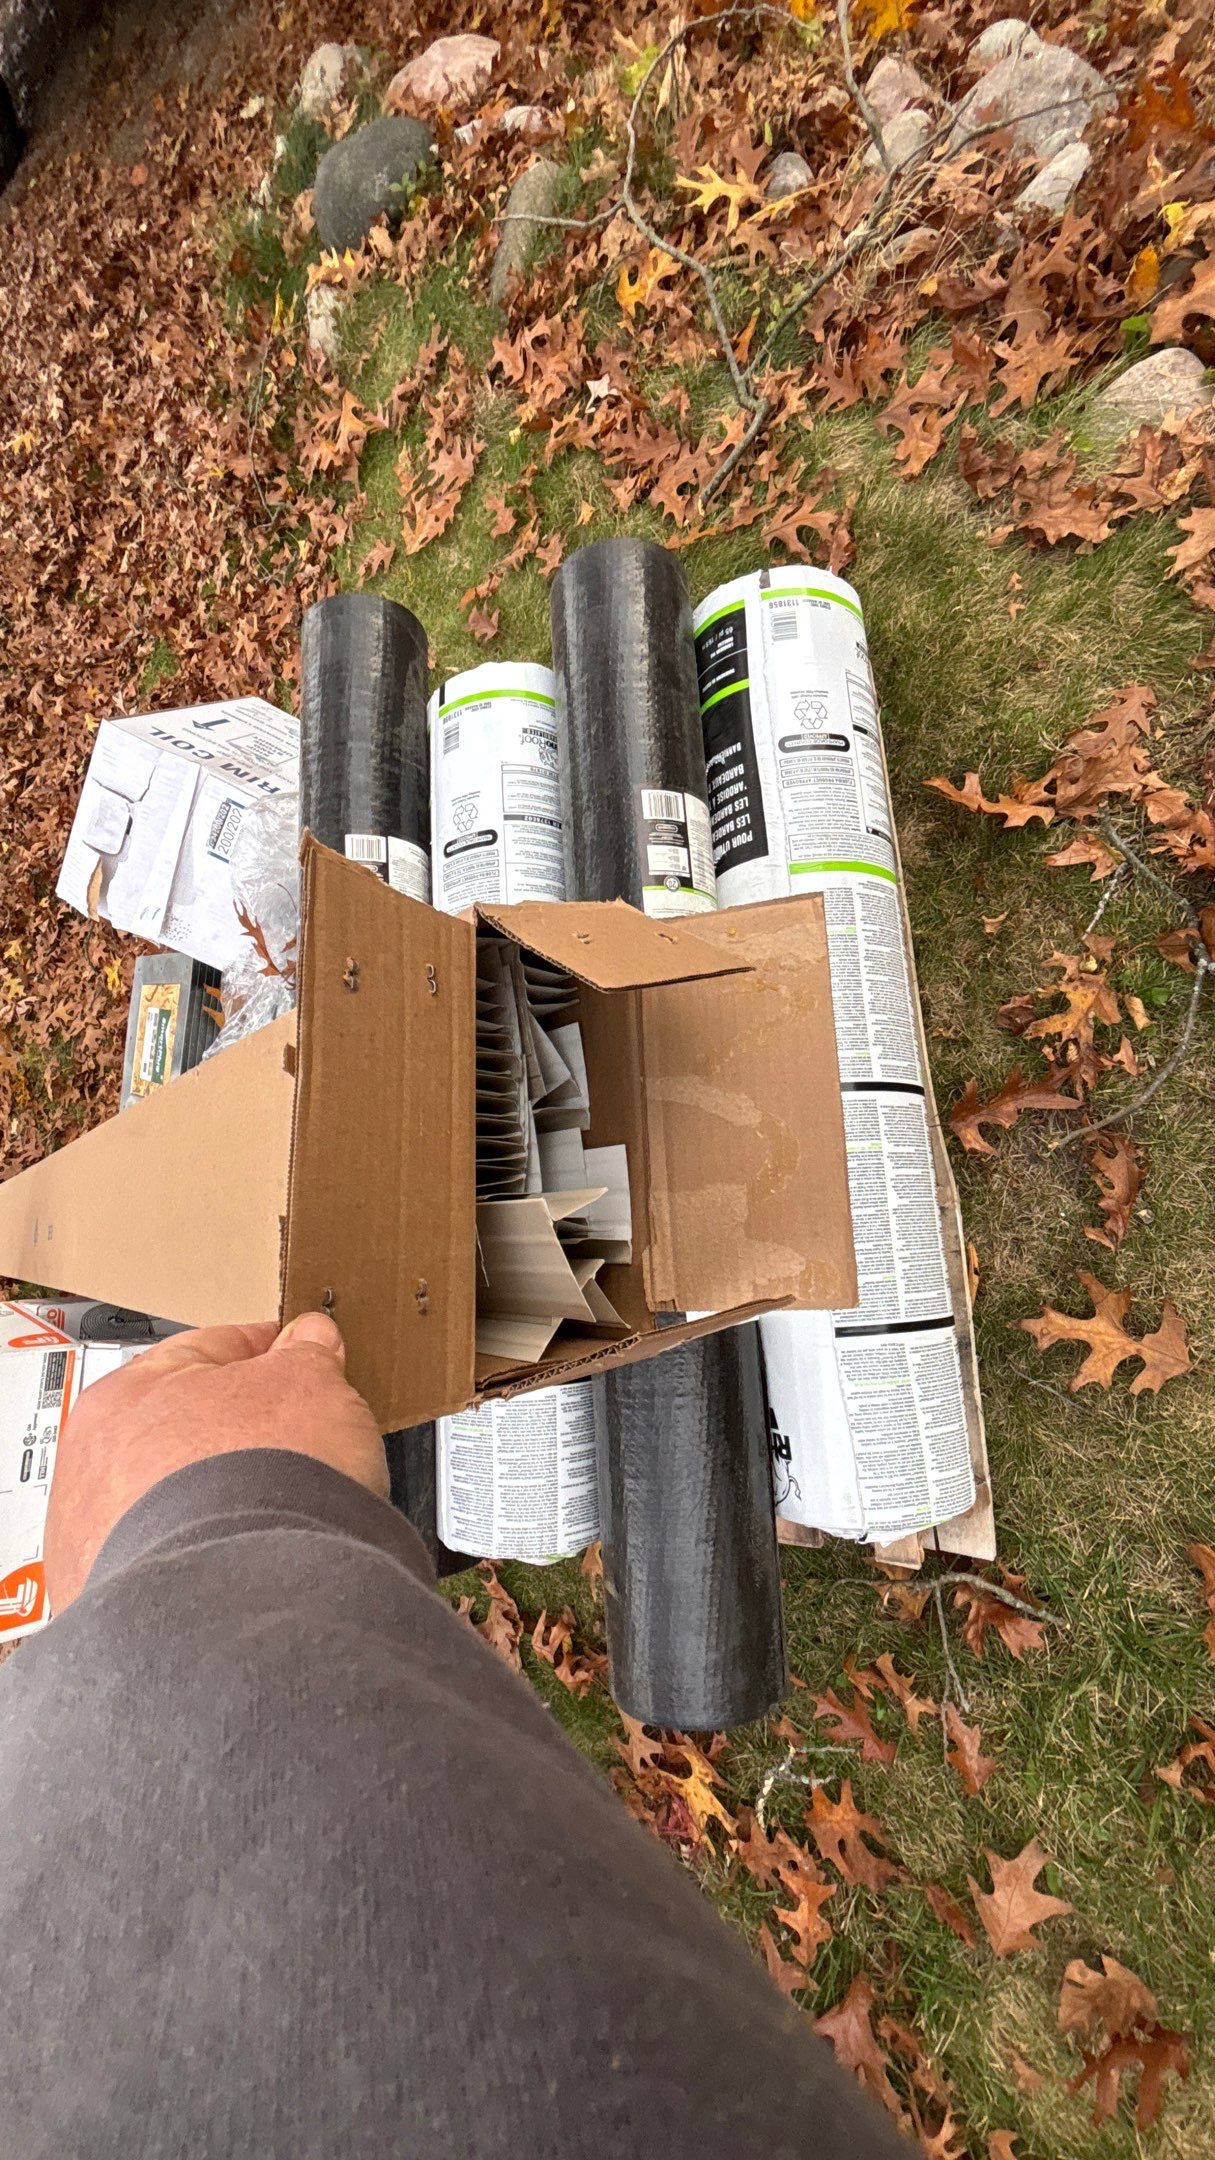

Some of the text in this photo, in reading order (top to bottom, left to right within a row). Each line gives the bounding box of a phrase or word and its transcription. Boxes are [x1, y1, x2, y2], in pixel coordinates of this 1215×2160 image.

[768, 599, 800, 609] 1131856
[149, 726, 214, 760] COIL
[220, 764, 281, 793] RIM
[711, 796, 749, 825] LES BARDEA
[712, 812, 751, 843] LES BARDEA
[731, 829, 754, 849] POUR
